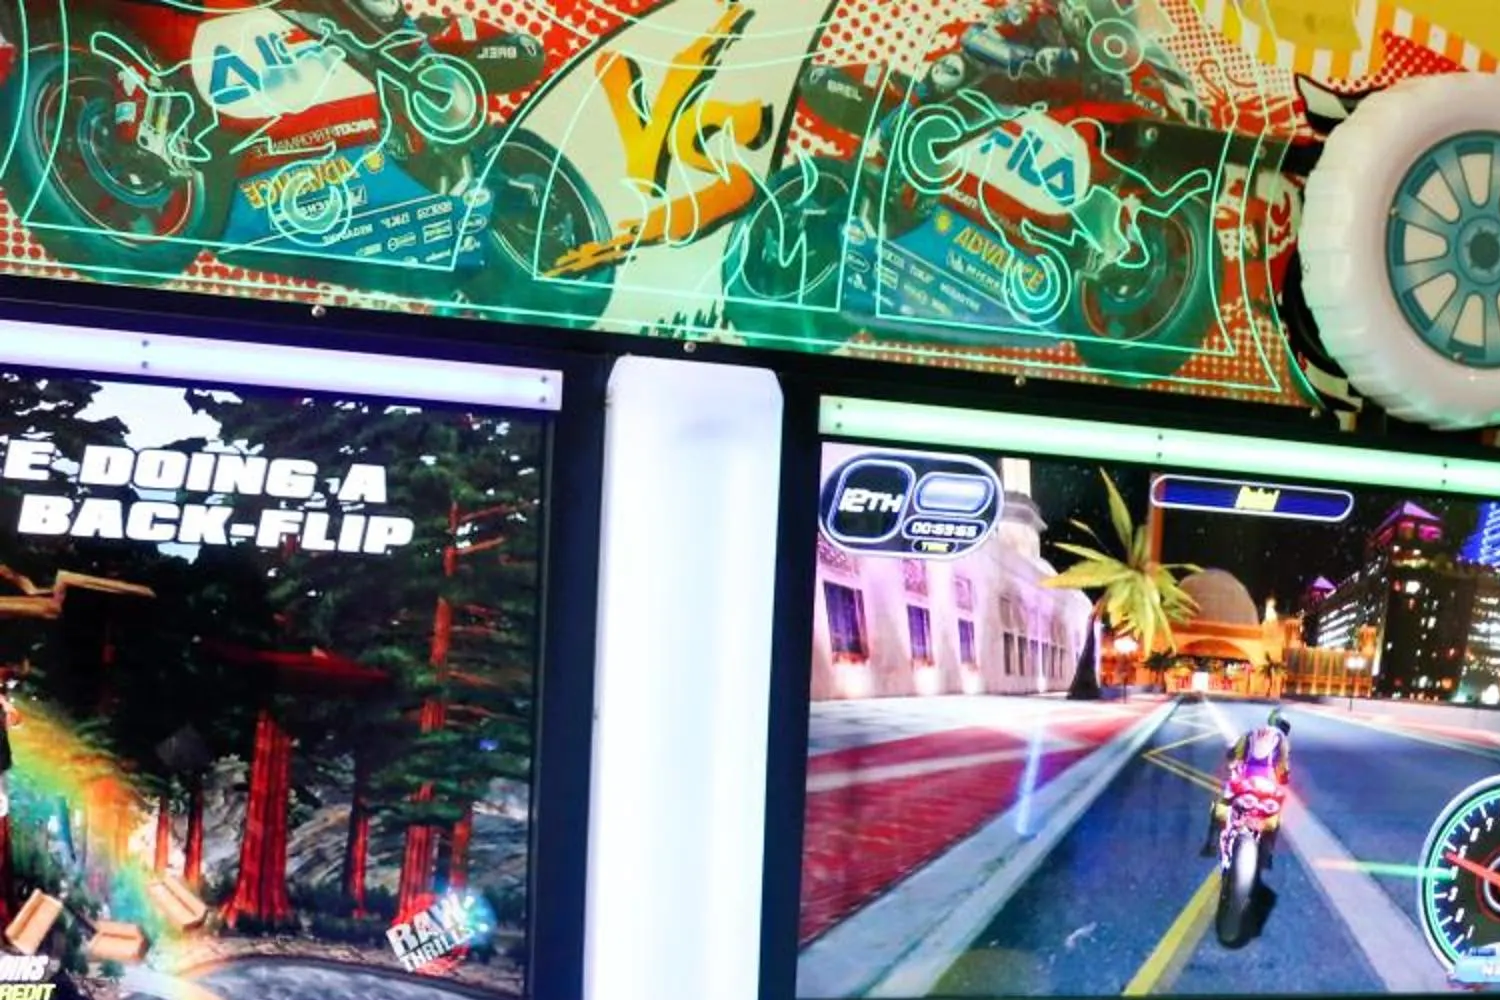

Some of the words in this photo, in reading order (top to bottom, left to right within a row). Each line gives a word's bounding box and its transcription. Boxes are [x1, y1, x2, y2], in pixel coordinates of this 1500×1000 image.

[978, 127, 1077, 207] FILA
[79, 444, 318, 498] DOING
[338, 463, 387, 503] A
[838, 486, 904, 513] 12TH
[17, 493, 415, 555] BACK-FLIP
